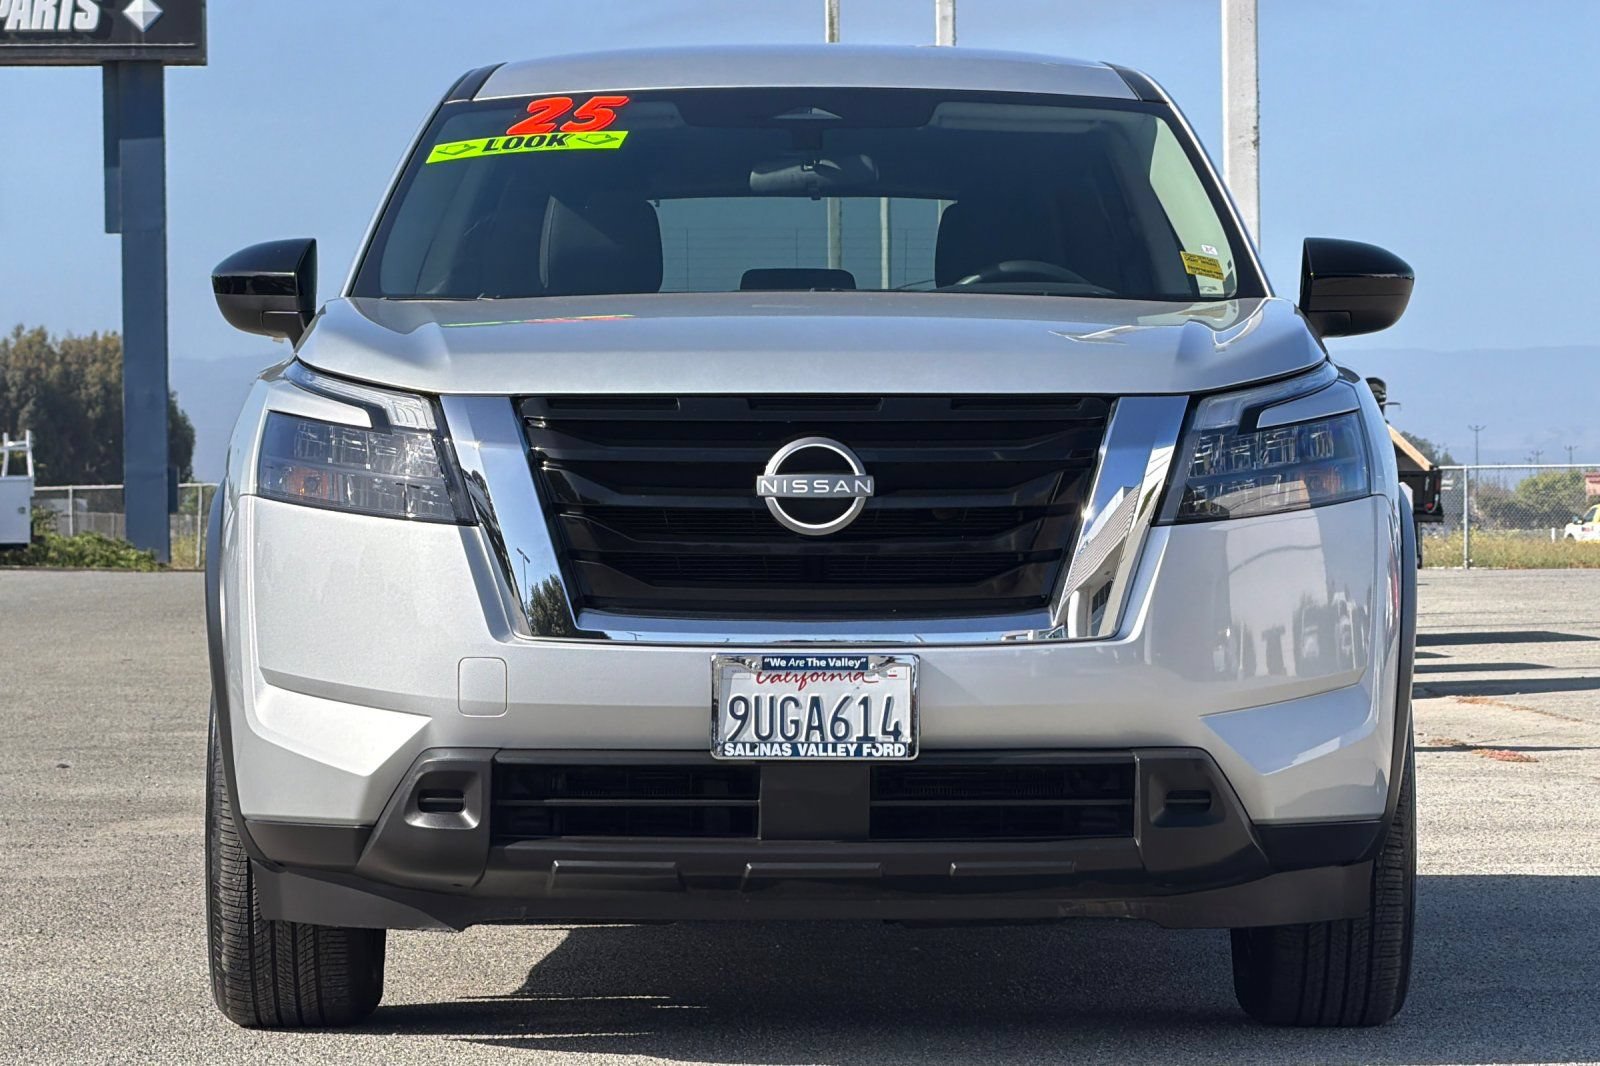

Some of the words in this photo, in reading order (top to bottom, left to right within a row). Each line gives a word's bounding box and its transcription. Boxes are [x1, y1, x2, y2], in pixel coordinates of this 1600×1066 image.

[506, 95, 630, 135] 25
[482, 133, 576, 152] LOOK
[760, 479, 871, 493] NISSAN
[788, 658, 805, 667] Are
[806, 658, 828, 667] The
[727, 694, 902, 742] 9UGA614
[724, 743, 793, 756] SALINAS
[799, 743, 857, 756] VALLEY
[862, 743, 906, 756] FORD
